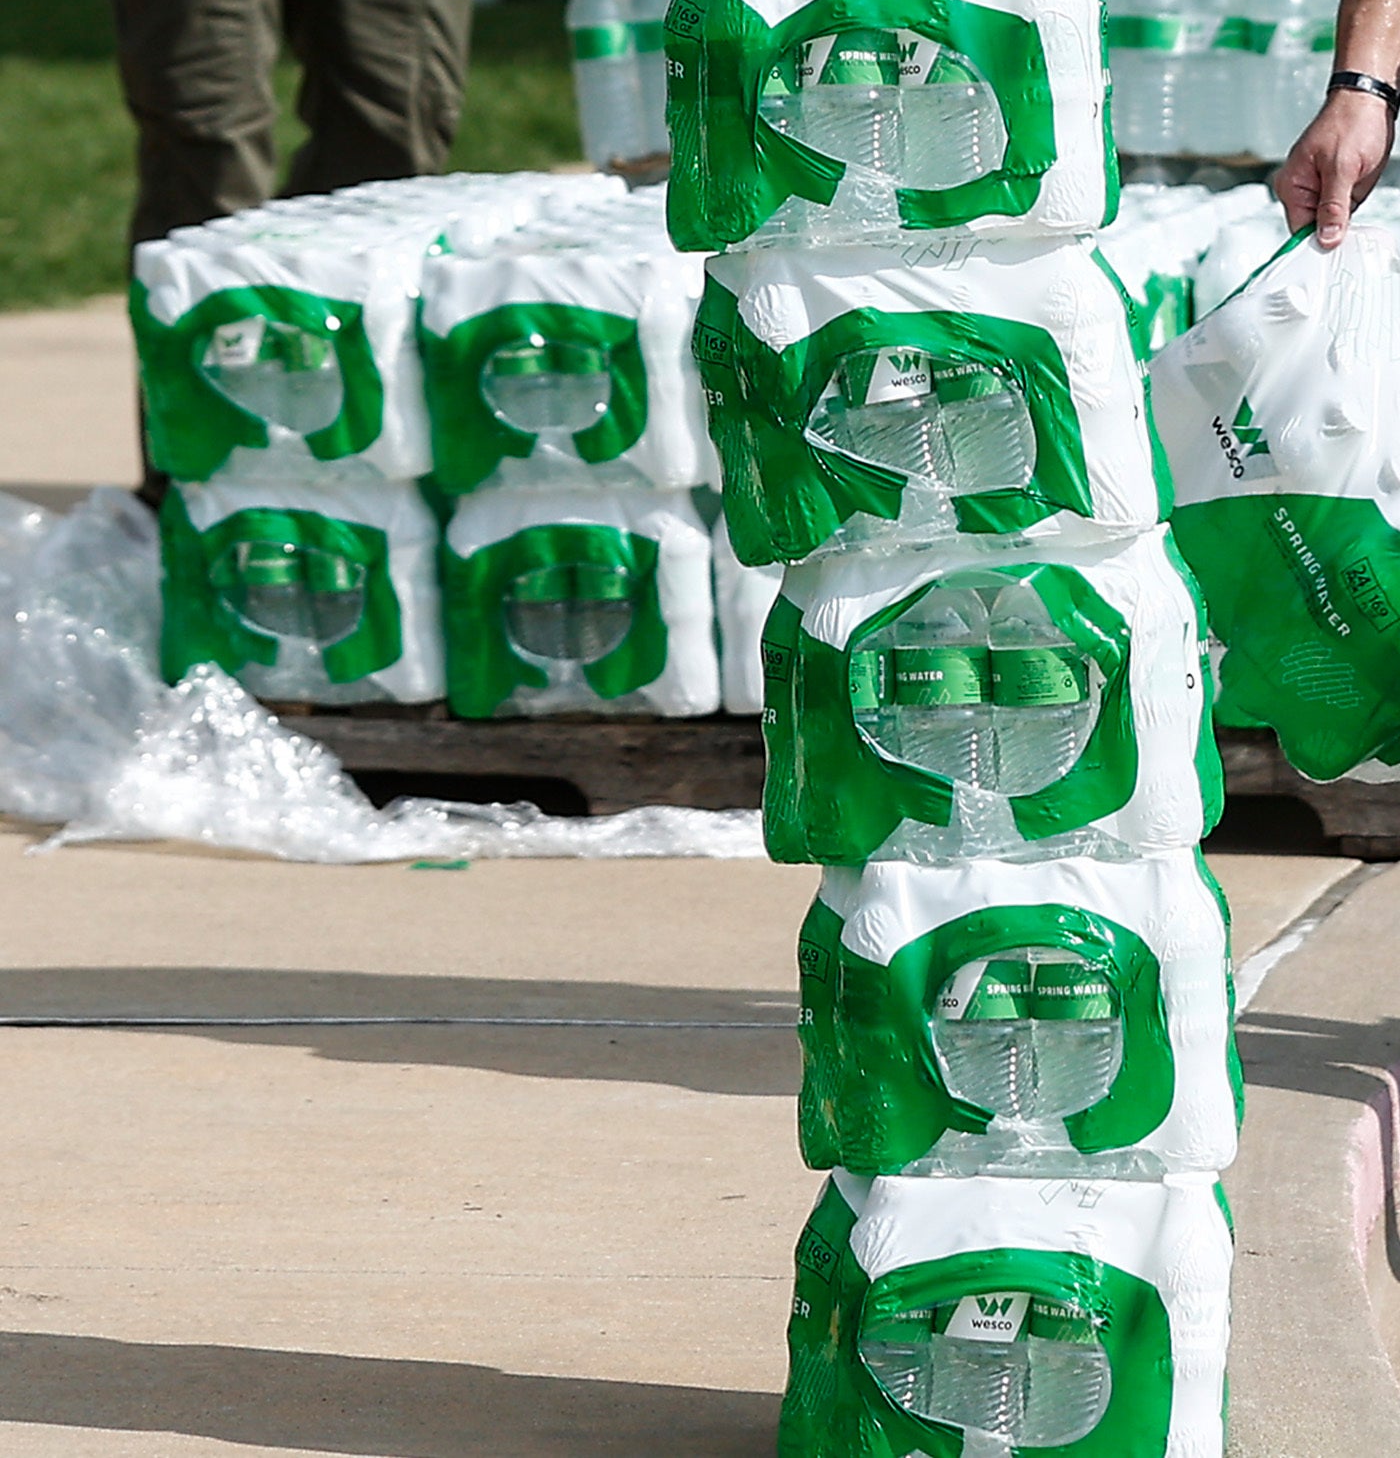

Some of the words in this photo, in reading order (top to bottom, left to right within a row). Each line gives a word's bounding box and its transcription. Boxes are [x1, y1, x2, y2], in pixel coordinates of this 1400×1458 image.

[891, 374, 927, 388] wesco
[1211, 415, 1245, 479] wesco
[1273, 507, 1321, 575] SPRING
[1315, 573, 1351, 637] WATER
[909, 671, 944, 682] WATER
[987, 984, 1021, 995] SPRING
[1038, 986, 1070, 997] SPRING
[942, 998, 959, 1008] sco
[971, 1318, 1013, 1331] wesco
